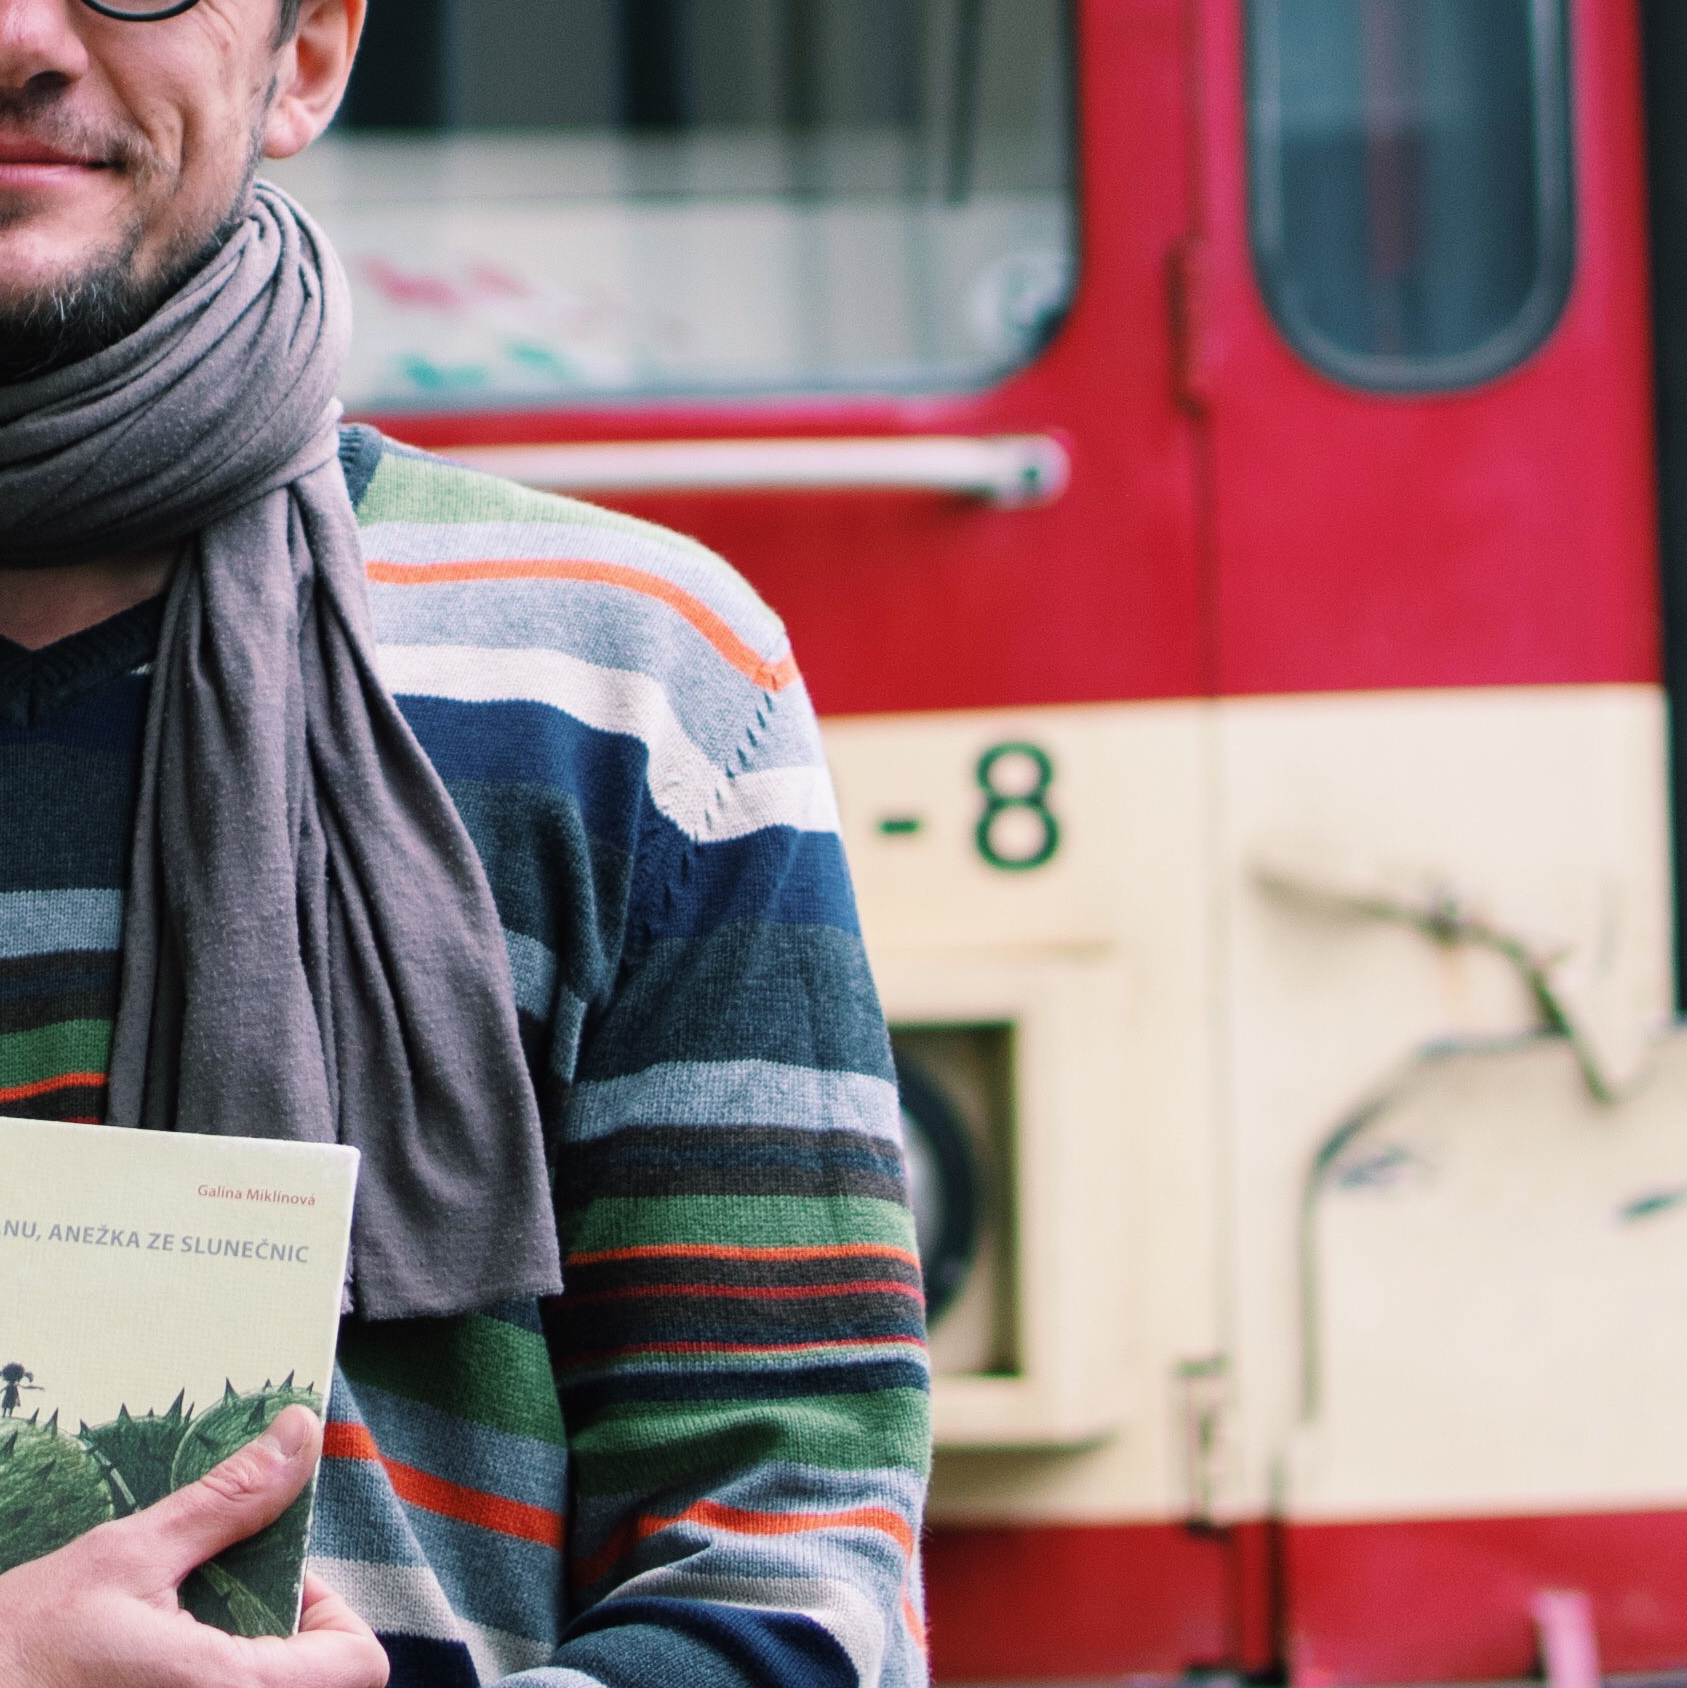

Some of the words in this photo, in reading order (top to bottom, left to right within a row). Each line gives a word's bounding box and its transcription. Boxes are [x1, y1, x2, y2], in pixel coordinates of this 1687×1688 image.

[197, 1184, 242, 1200] Galina
[246, 1188, 316, 1206] Miklínová
[48, 1224, 141, 1249] ANEŽKA
[146, 1232, 175, 1252] ZE
[180, 1235, 310, 1264] SLUNEČNIC
